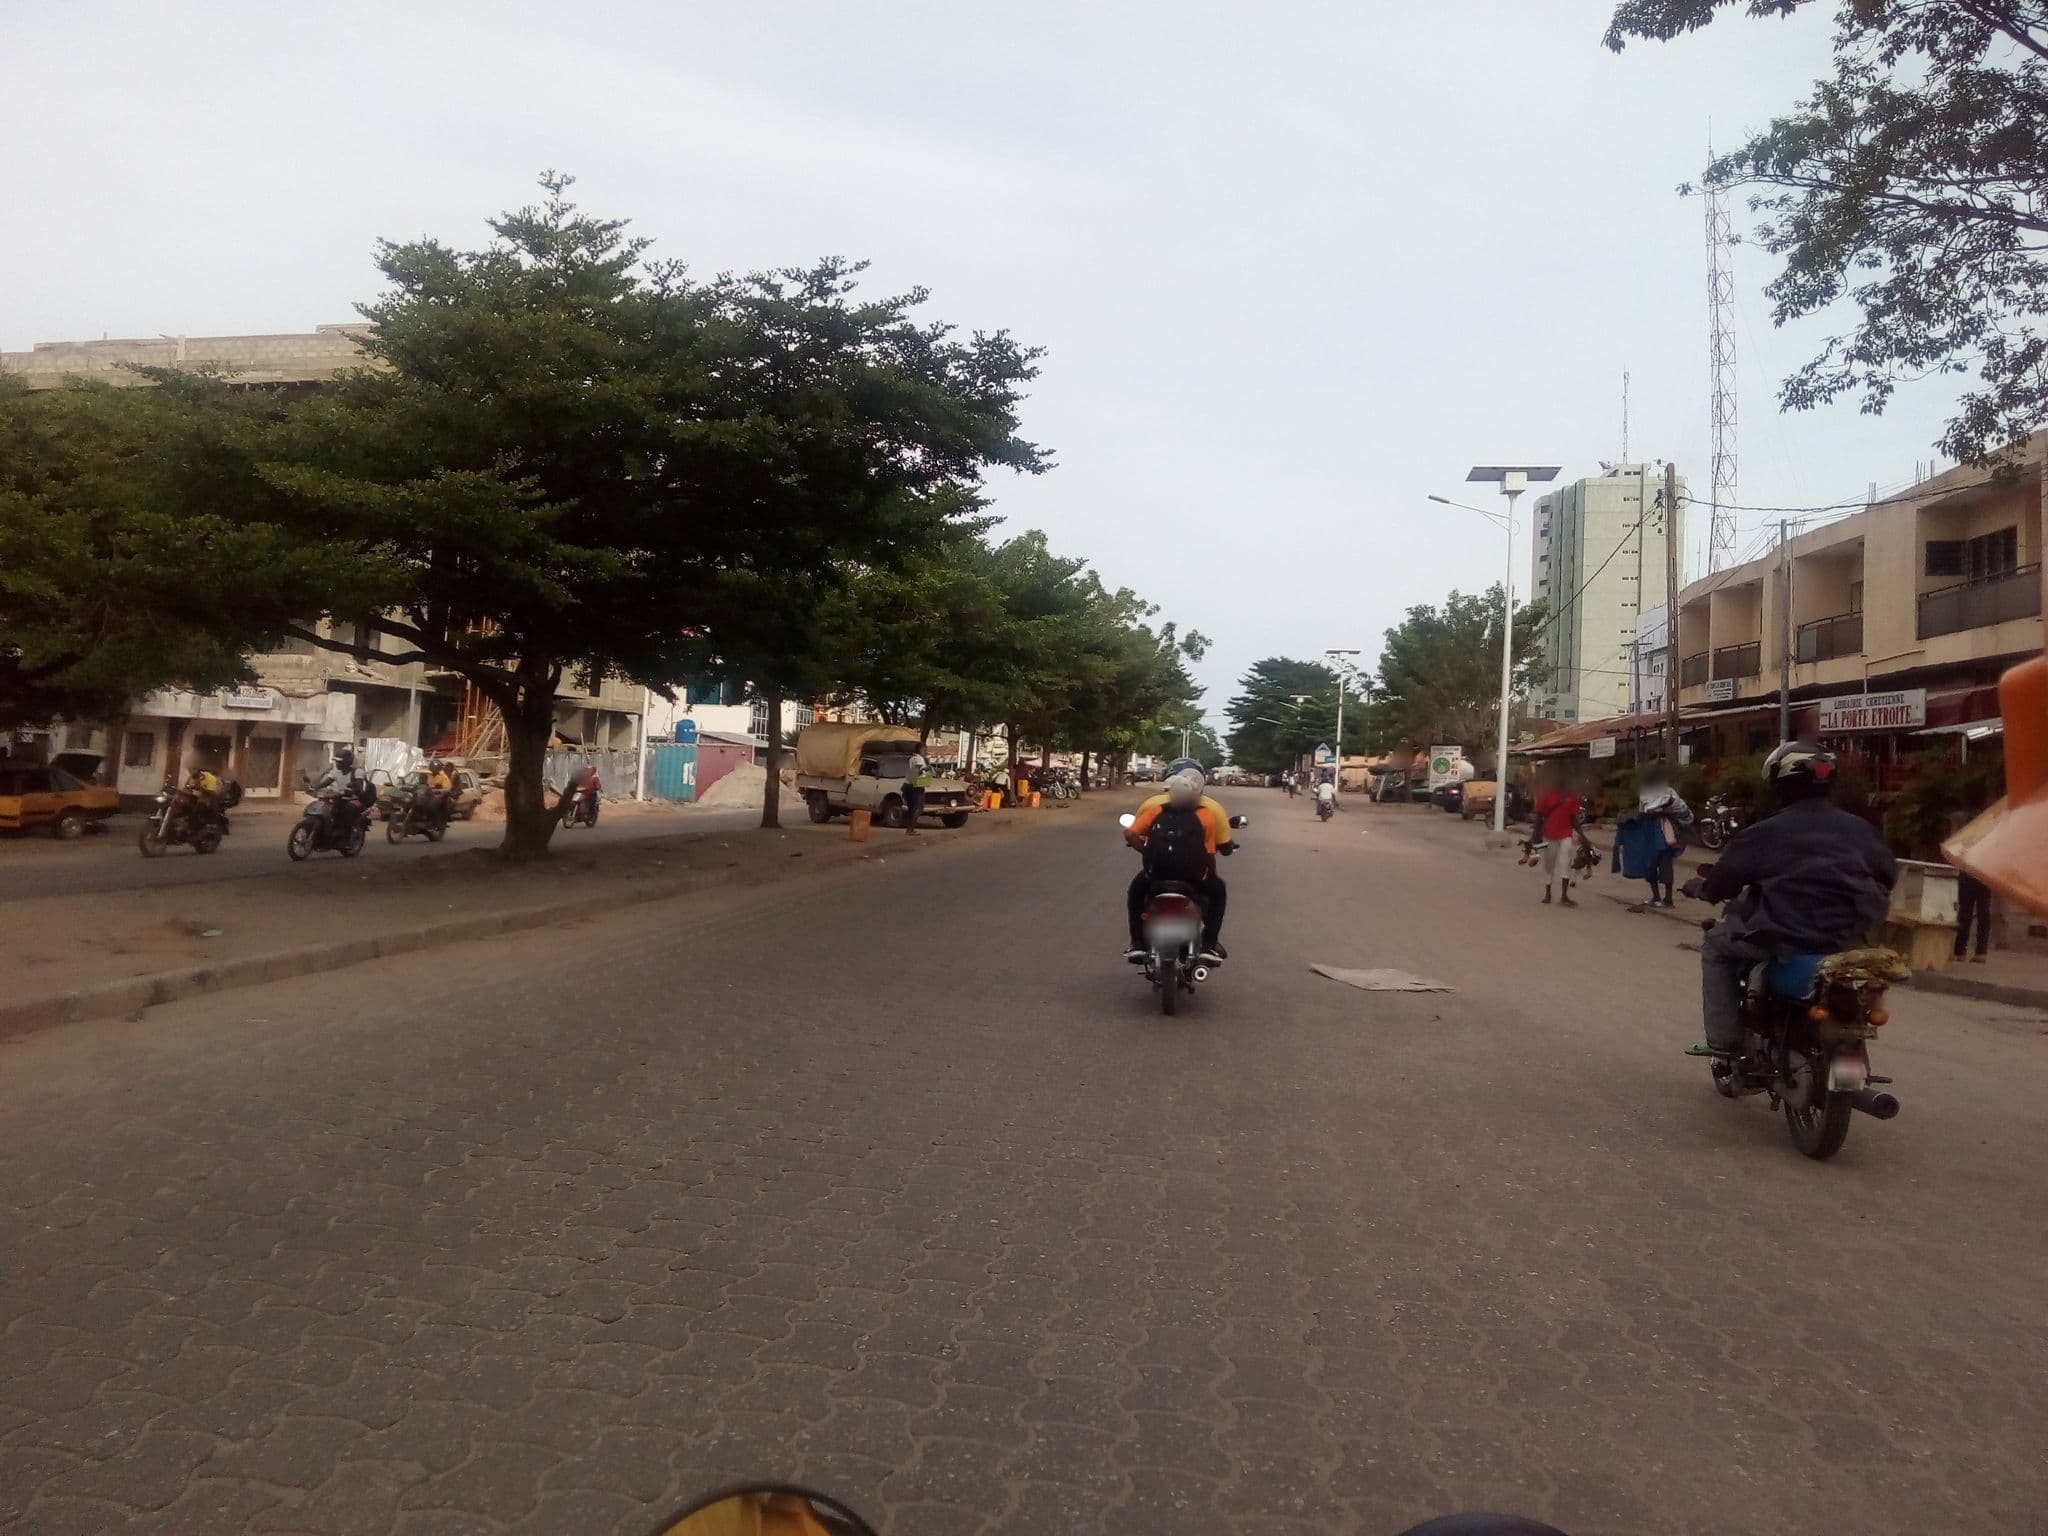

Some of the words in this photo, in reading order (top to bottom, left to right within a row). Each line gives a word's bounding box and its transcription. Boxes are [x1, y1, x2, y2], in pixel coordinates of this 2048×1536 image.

[1829, 711, 1838, 728] LA
[1841, 709, 1868, 728] PORTE
[1872, 705, 1911, 726] ETROITE
